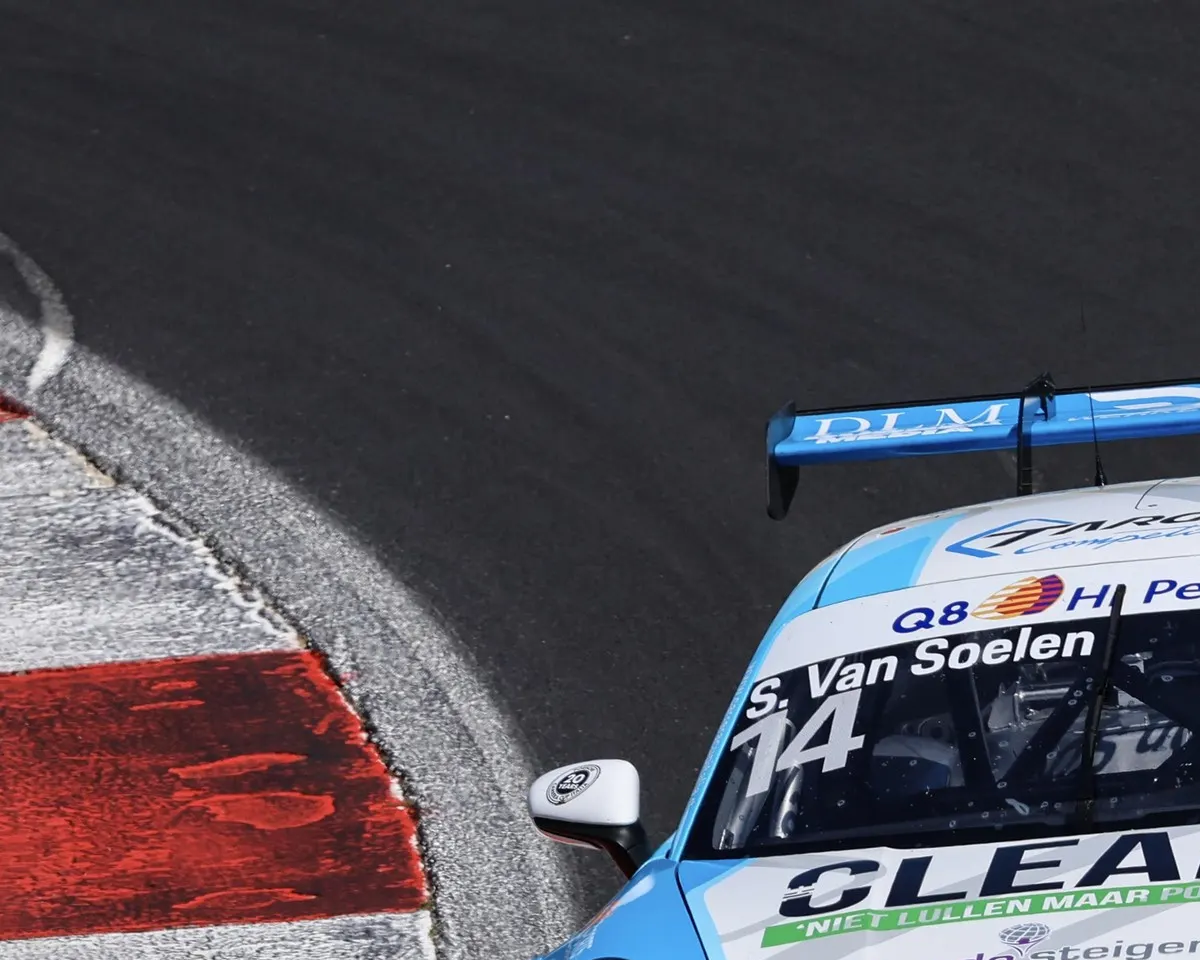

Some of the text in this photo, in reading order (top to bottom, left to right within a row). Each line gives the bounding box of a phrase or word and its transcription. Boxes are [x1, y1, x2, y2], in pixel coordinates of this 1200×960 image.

[808, 403, 1009, 440] DLM
[892, 599, 969, 634] Q8
[746, 627, 1096, 720] S. Van Soelen
[730, 687, 865, 798] 14
[562, 773, 586, 784] 20
[896, 899, 1032, 927] LULLEN
[1041, 888, 1150, 911] MAAR
